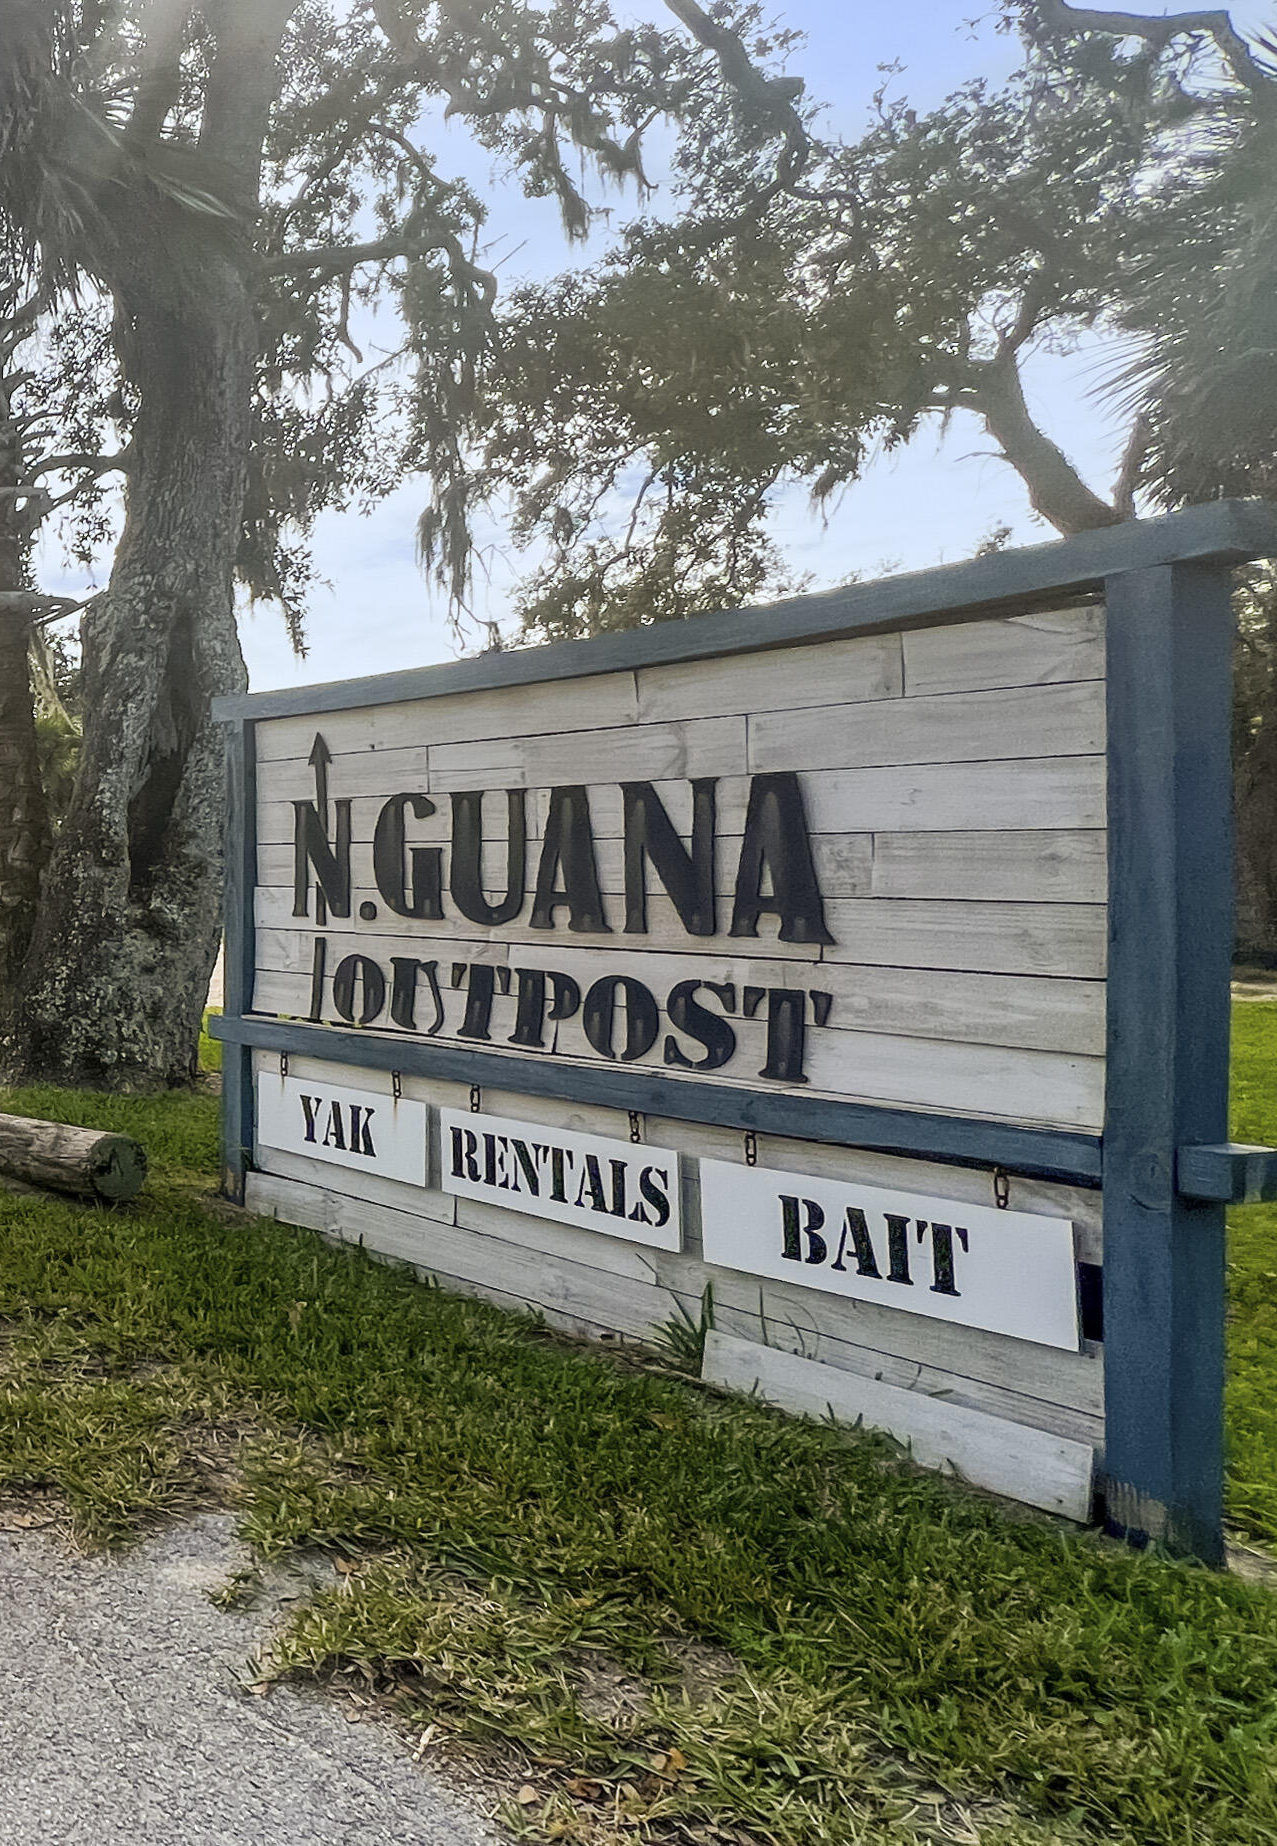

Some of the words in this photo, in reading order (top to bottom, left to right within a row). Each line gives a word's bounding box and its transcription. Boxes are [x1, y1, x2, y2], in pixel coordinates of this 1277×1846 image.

[332, 952, 834, 1084] OUTPOST
[299, 1094, 377, 1158] YAK
[449, 1125, 672, 1229] RENTALS
[778, 1194, 969, 1297] BAIT
